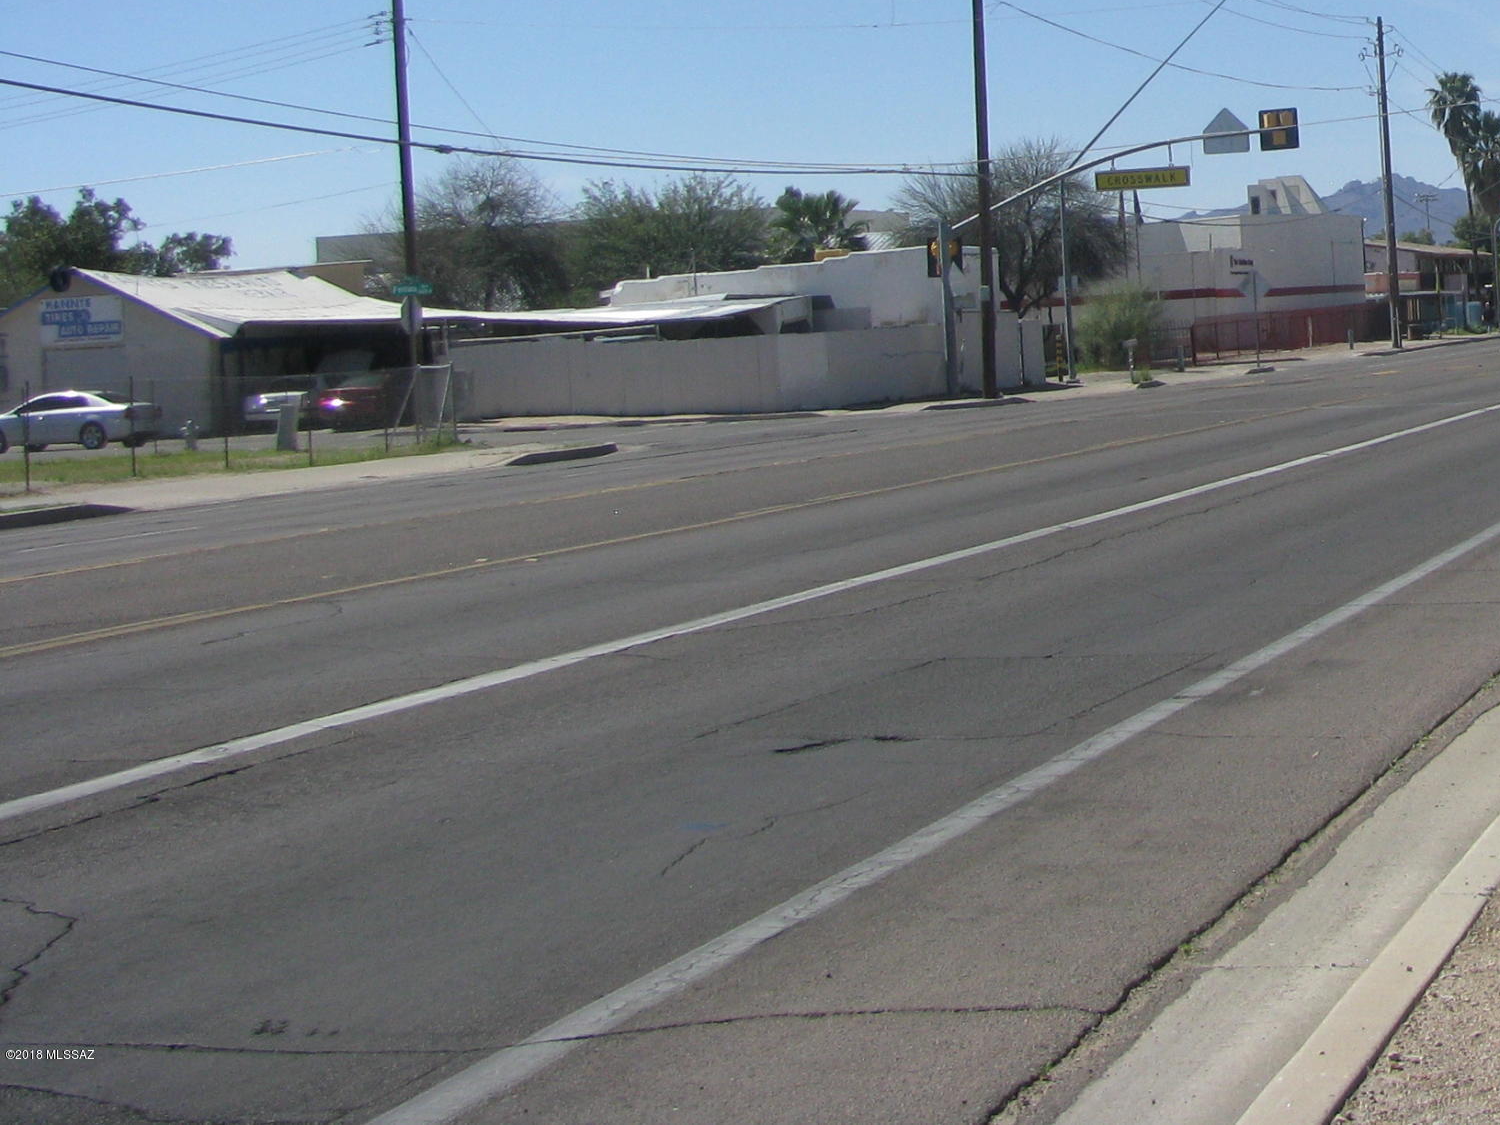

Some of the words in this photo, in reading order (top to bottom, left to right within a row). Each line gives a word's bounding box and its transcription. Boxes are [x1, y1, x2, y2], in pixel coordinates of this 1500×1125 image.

[1107, 172, 1176, 186] CROSSWALK
[45, 311, 74, 323] TIRES
[61, 324, 84, 335] AUTO
[88, 321, 120, 333] REPAIR
